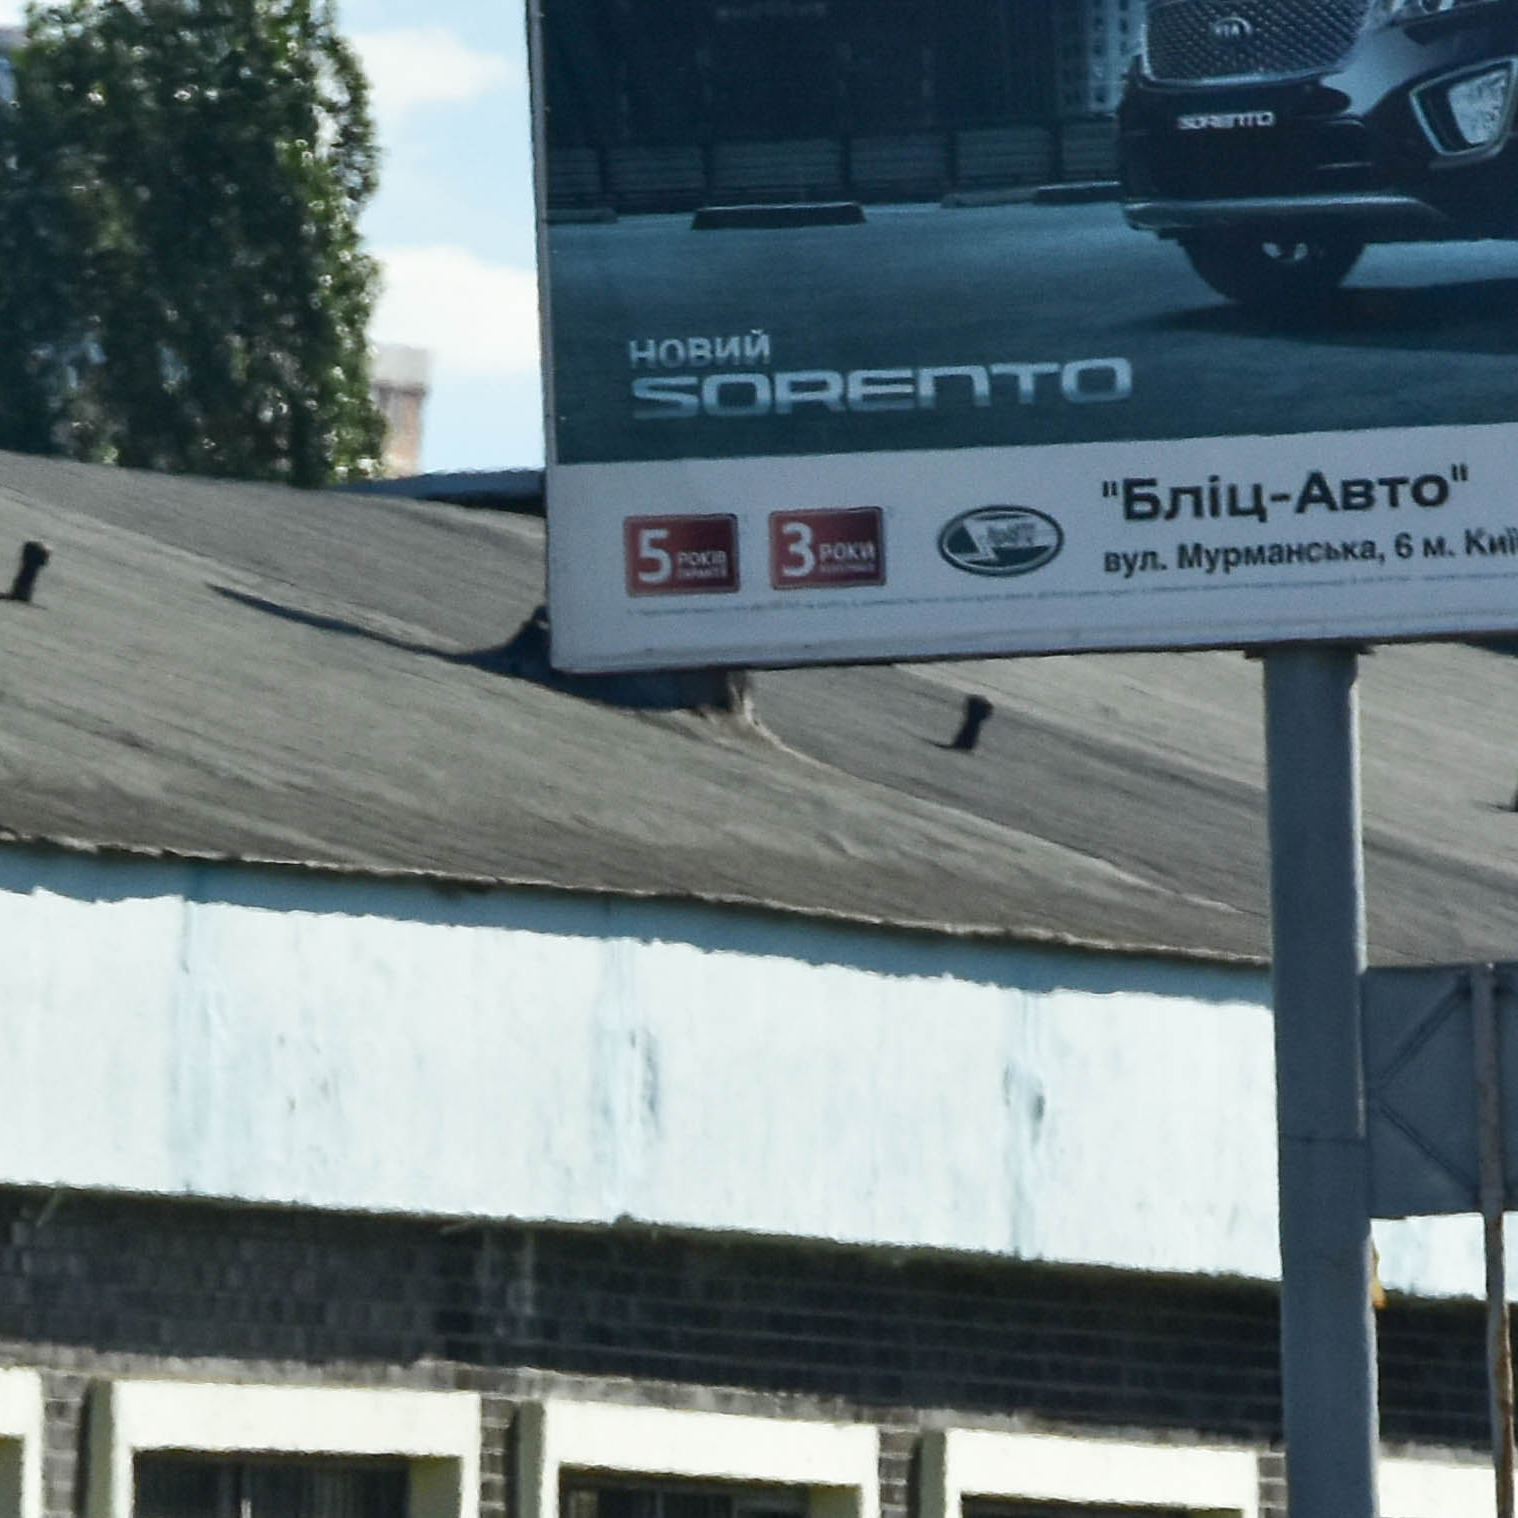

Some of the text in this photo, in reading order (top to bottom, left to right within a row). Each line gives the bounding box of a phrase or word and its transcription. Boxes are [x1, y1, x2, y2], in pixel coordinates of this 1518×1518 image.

[630, 329, 771, 369] НОВИЙ
[632, 356, 1133, 420] SORENTO
[1102, 463, 1470, 523] "Бліц-Авто"
[637, 528, 673, 584] 5
[781, 521, 817, 577] 3
[1104, 526, 1518, 578] вул. Мурманська, 6 м. Киї
